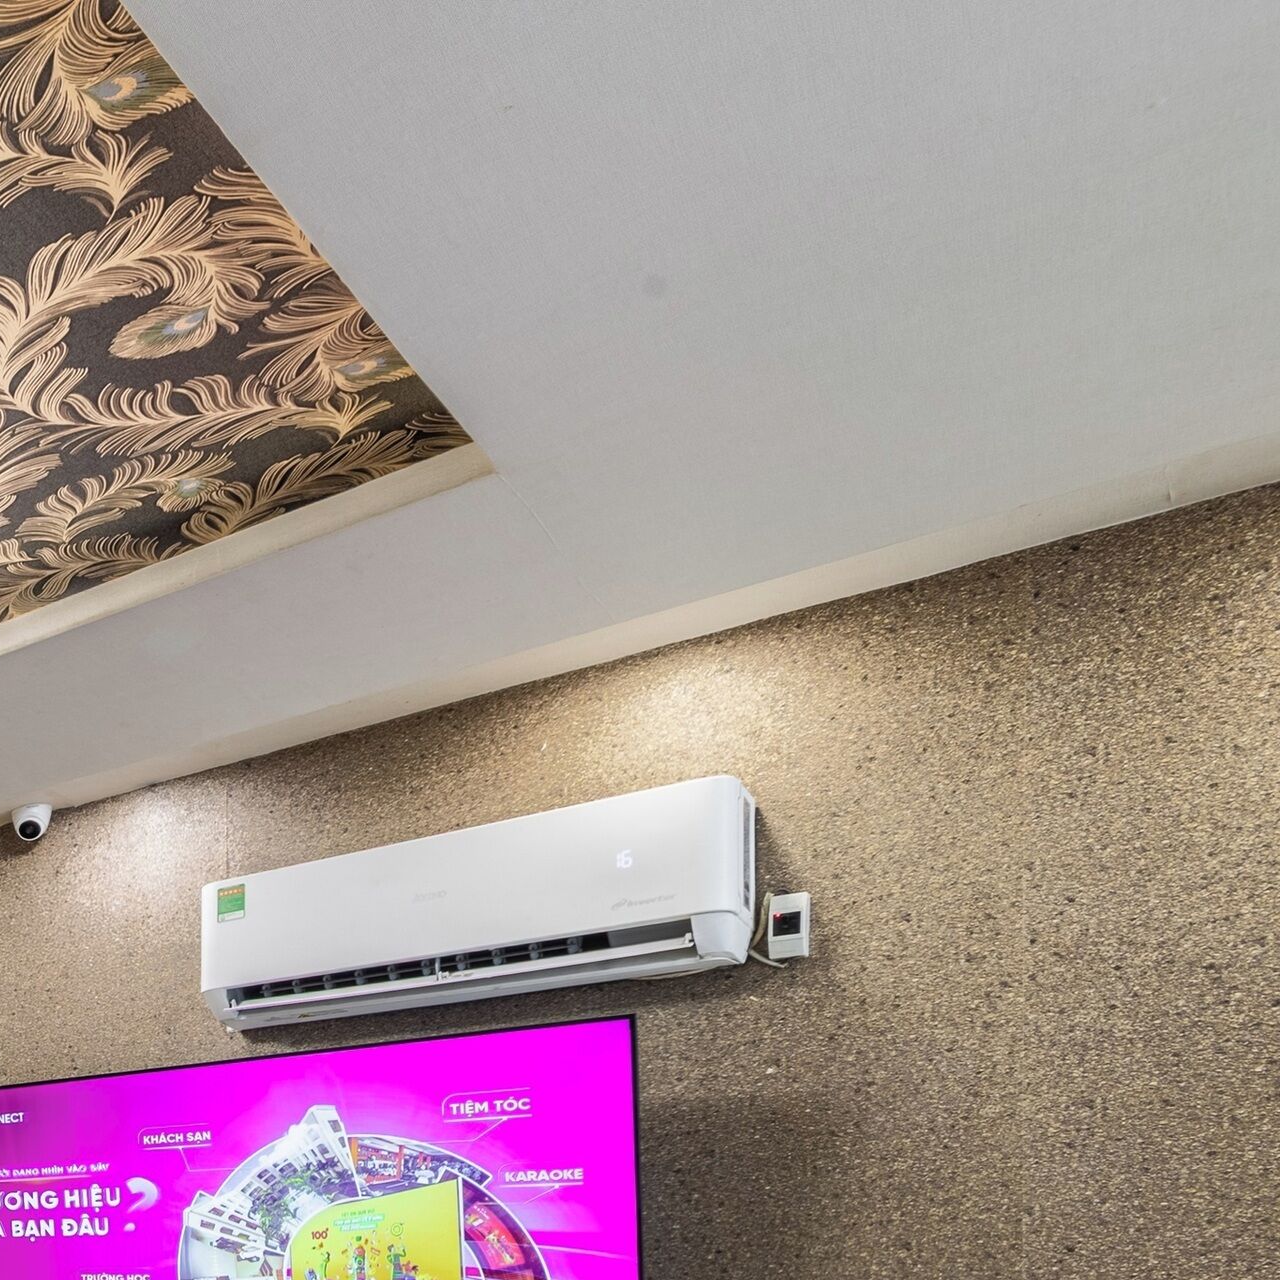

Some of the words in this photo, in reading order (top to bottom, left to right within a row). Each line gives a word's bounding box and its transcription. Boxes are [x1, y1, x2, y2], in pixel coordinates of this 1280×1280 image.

[449, 1100, 489, 1117] TIỆM
[493, 1096, 531, 1112] TÓC
[143, 1132, 184, 1145] KHÁCH
[186, 1131, 211, 1144] SẠN
[66, 1162, 87, 1174] VÀO
[504, 1168, 584, 1182] KARAOKE
[63, 1184, 121, 1212] HIỆU
[124, 1176, 161, 1232] ?
[11, 1217, 55, 1242] BẠN
[61, 1213, 109, 1237] ĐÂU
